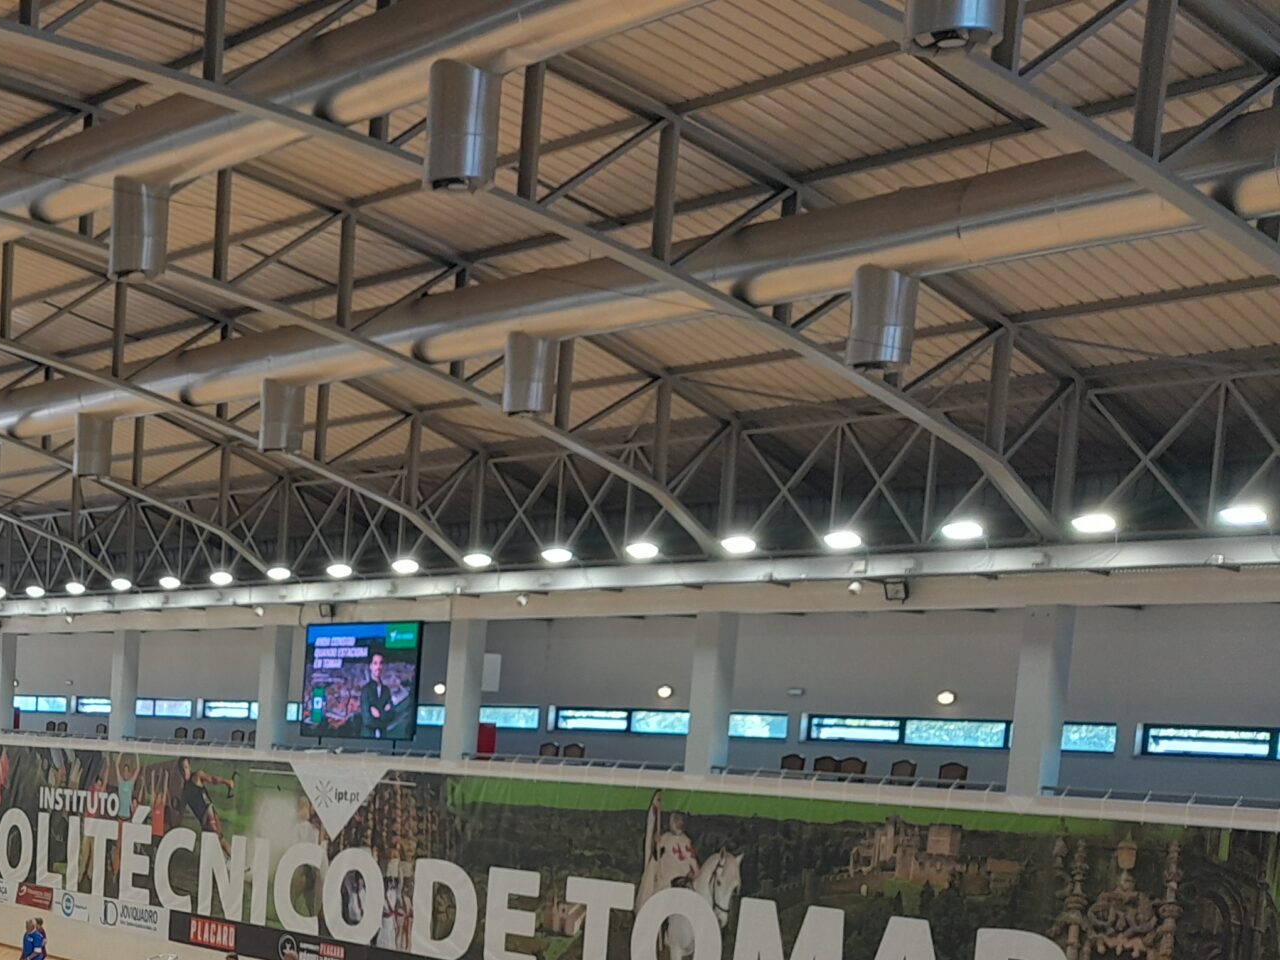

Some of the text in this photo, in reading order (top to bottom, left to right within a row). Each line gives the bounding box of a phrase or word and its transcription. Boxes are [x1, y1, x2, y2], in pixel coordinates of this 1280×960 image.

[39, 786, 120, 817] INSTITUTO
[334, 787, 360, 804] ipt.pt
[120, 904, 159, 925] JOVIQUADRO
[190, 919, 236, 948] PLACARD
